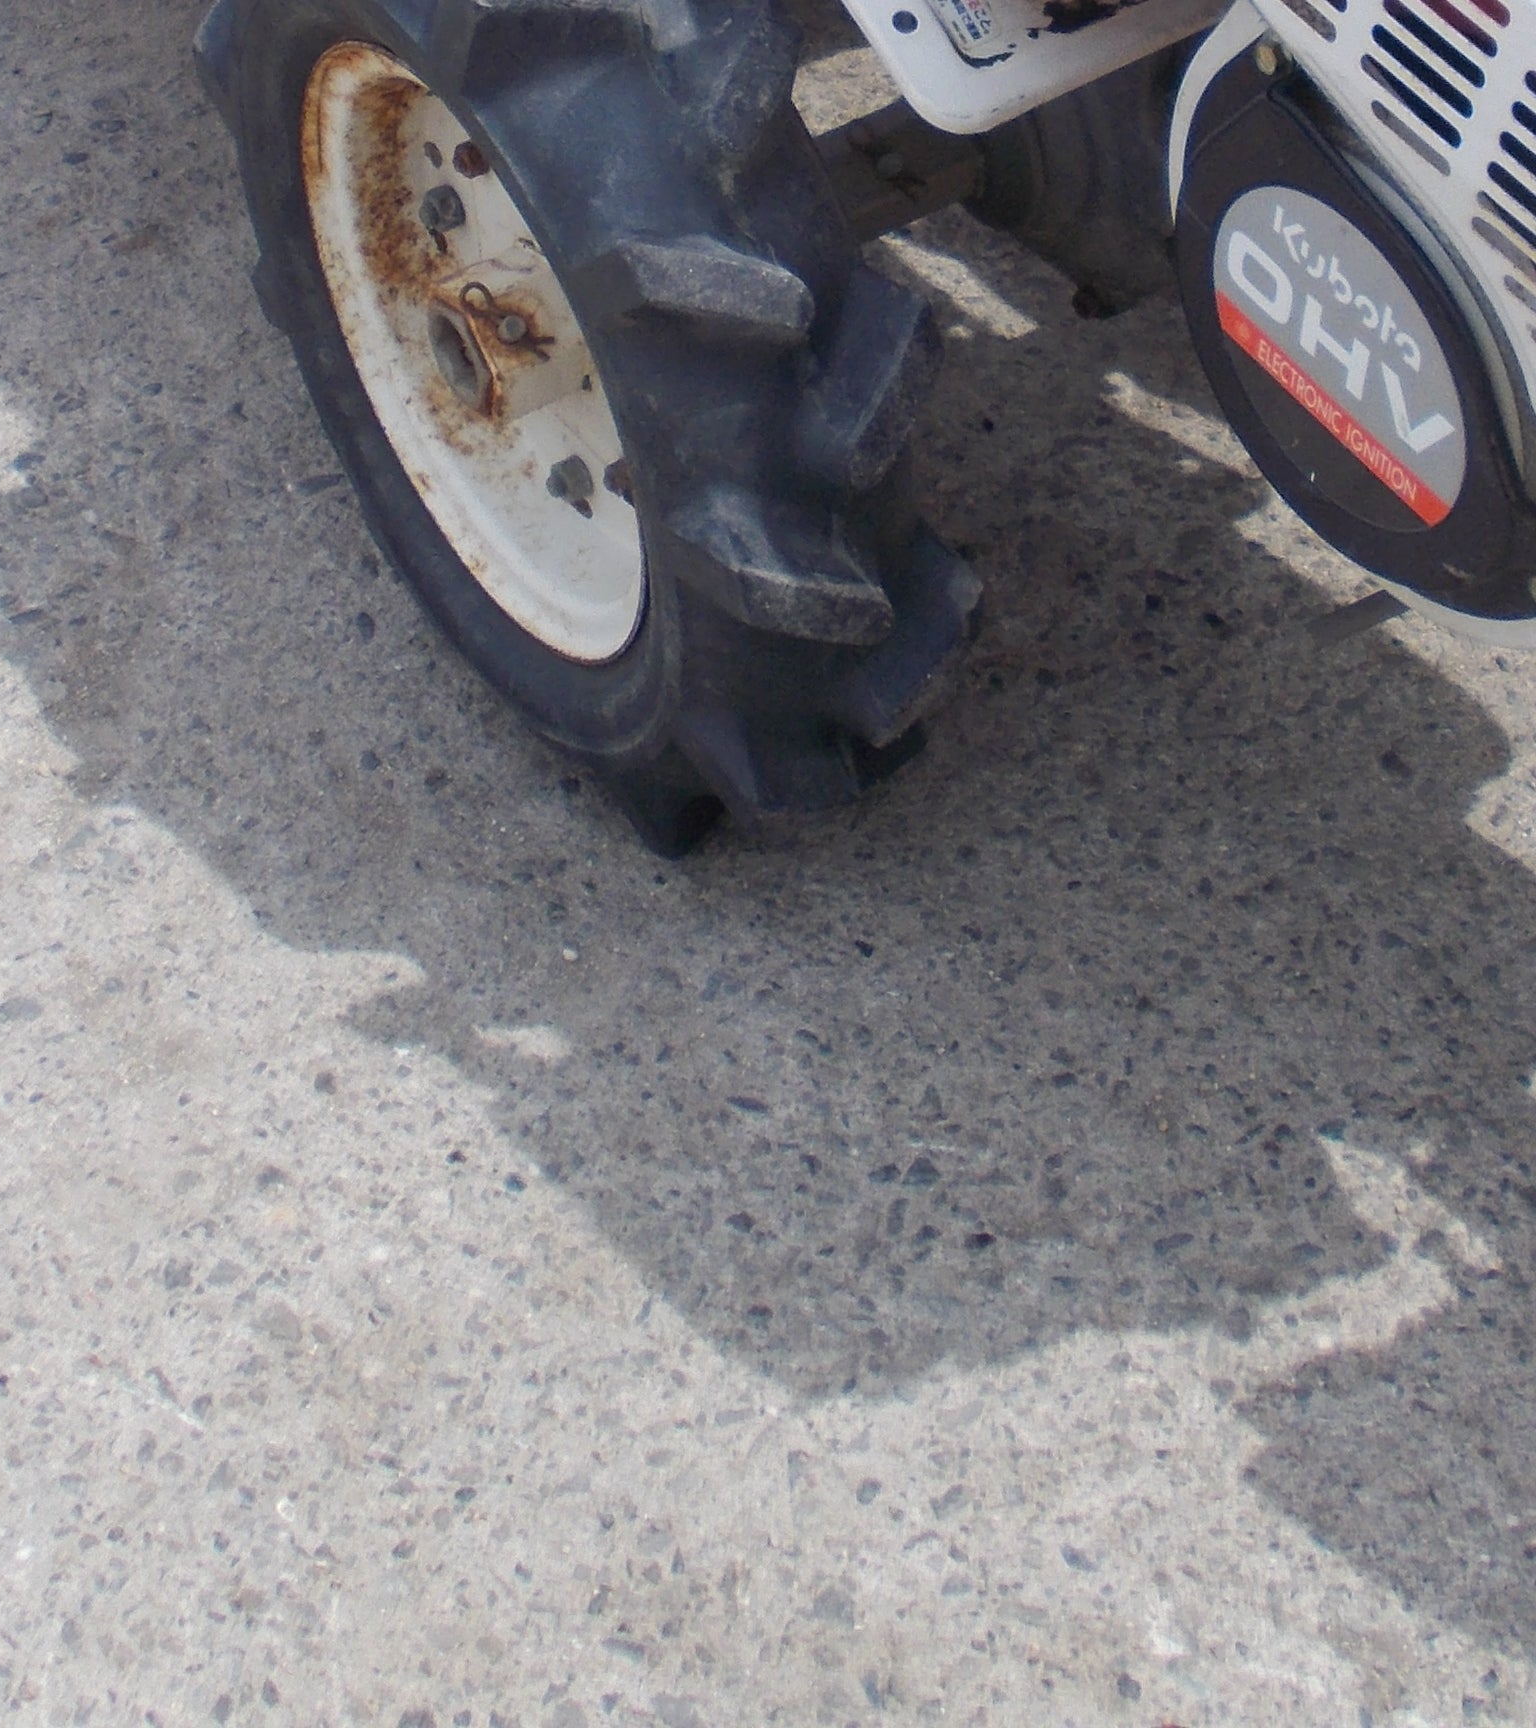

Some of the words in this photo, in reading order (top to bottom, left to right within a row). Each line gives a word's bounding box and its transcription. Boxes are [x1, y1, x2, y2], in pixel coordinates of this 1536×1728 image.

[1227, 229, 1456, 455] OHV
[1272, 204, 1422, 373] Kubota
[1257, 337, 1343, 435] ELECTRONIC
[1344, 425, 1419, 502] IGNITION
